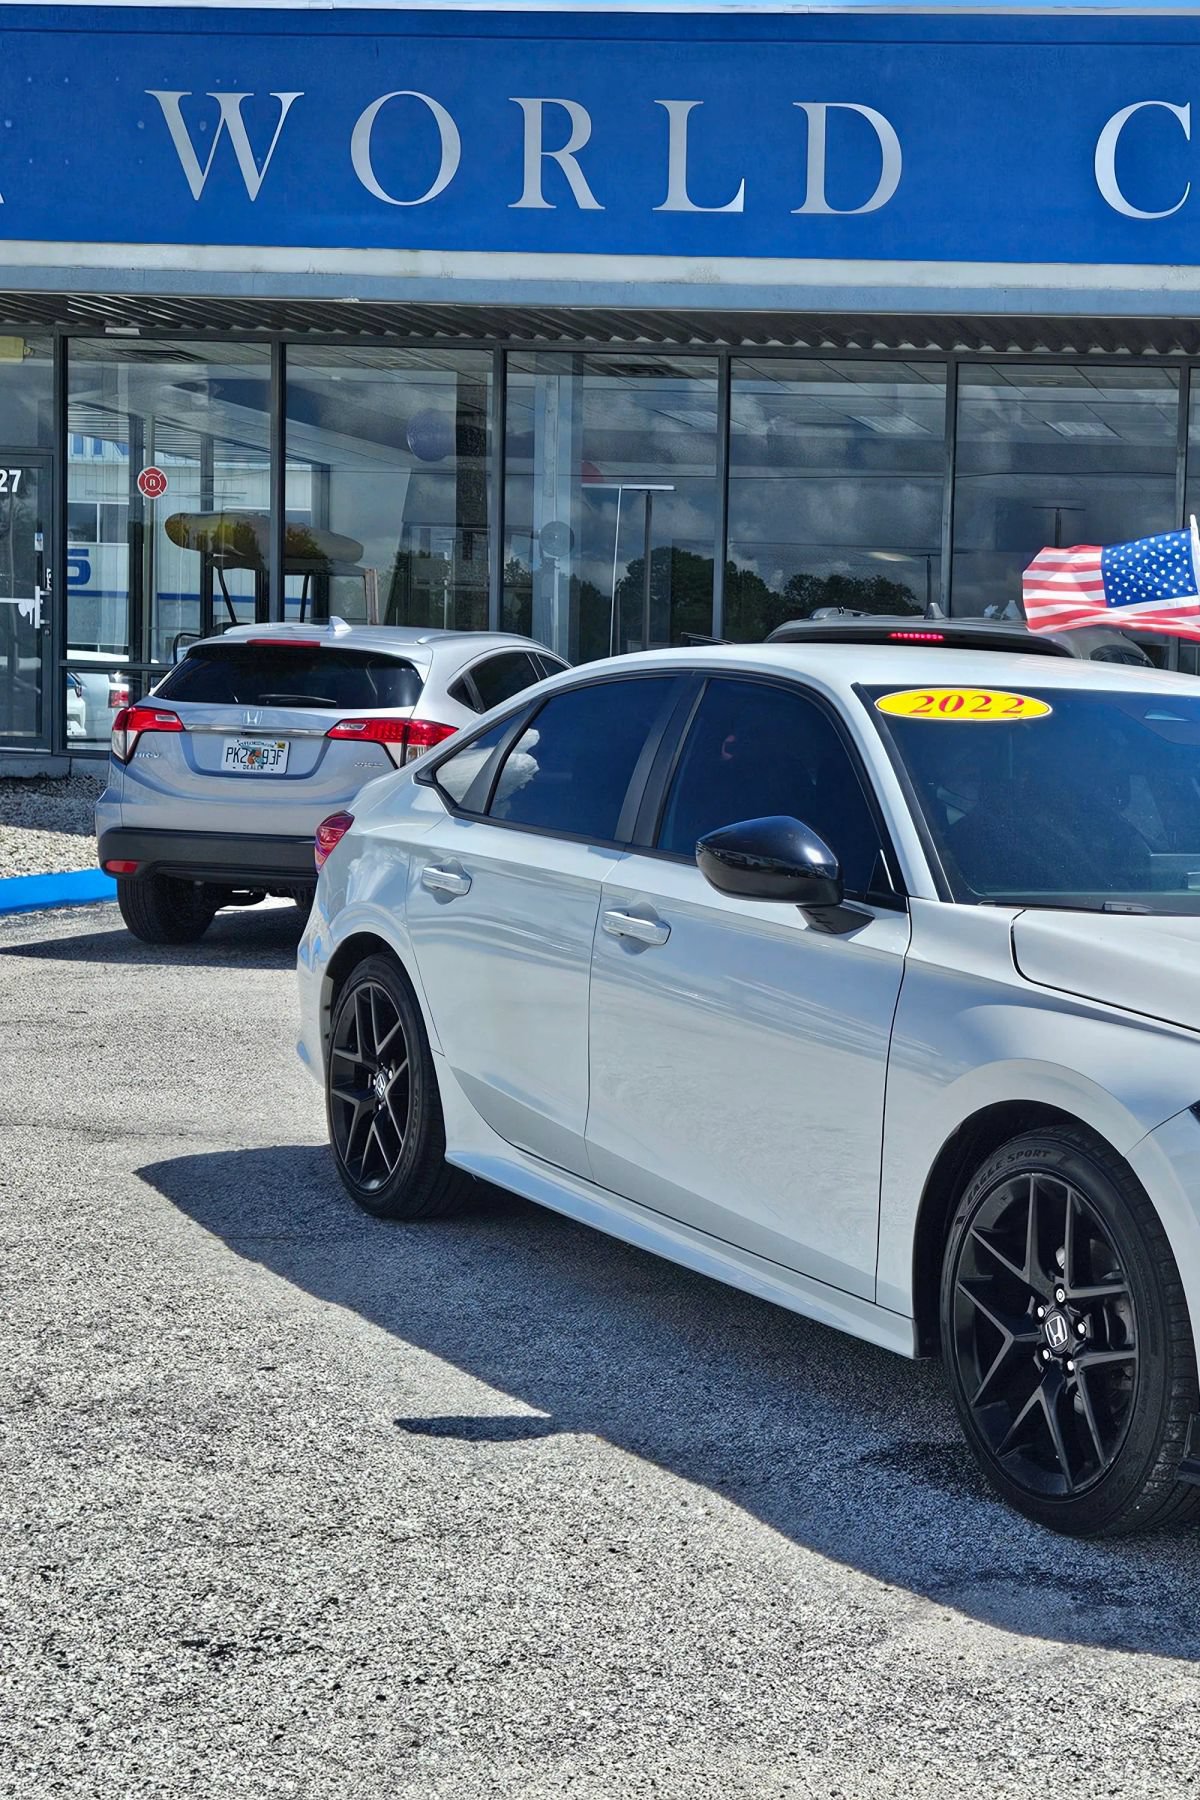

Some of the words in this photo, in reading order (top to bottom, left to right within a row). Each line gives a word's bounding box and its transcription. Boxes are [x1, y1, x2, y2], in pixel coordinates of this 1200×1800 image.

[145, 91, 902, 215] WORLD
[909, 694, 1025, 714] 2022
[968, 1161, 1004, 1202] EAGLE
[1007, 1149, 1051, 1163] SPORT
